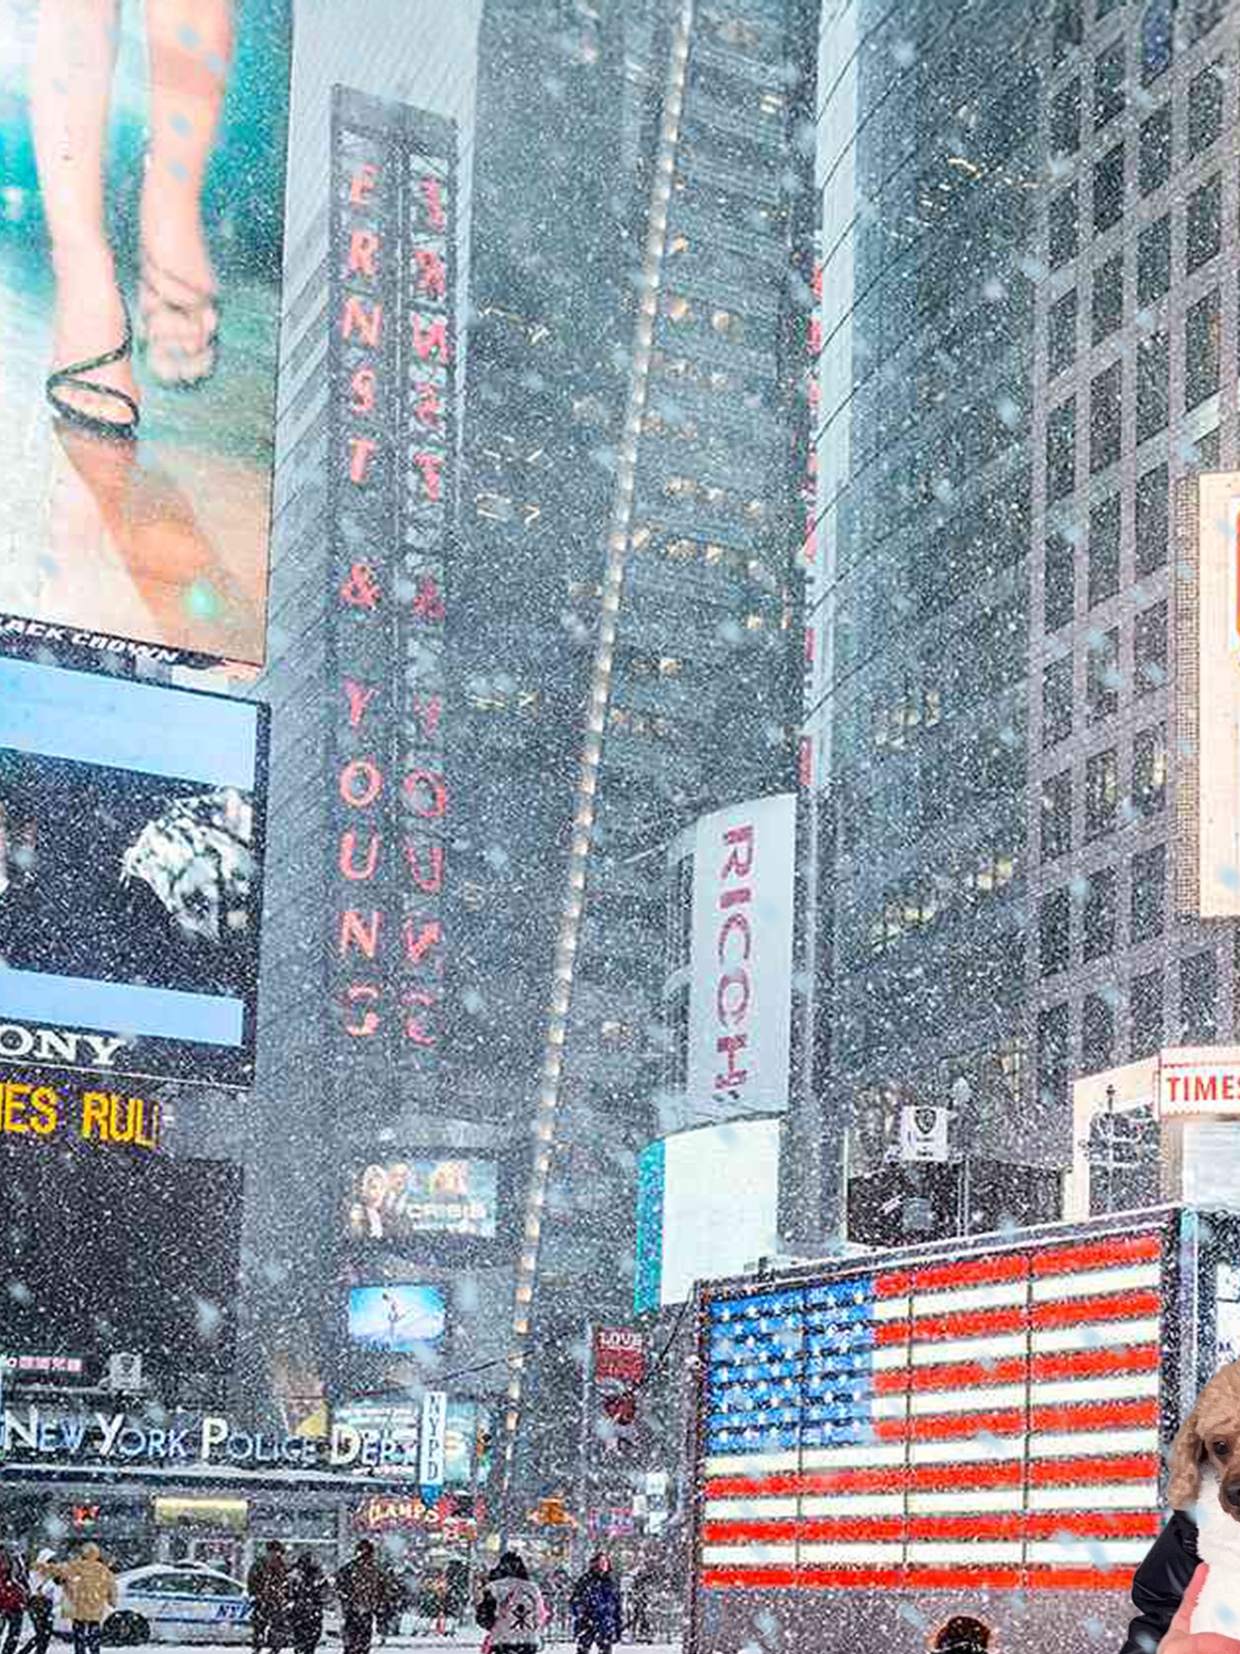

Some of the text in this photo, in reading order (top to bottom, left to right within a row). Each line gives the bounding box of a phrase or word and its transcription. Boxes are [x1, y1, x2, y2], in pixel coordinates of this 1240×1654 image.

[0, 615, 66, 642] ACK
[338, 162, 384, 1038] ERNST & YOUNG
[715, 825, 753, 1090] RICOH
[0, 1025, 125, 1066] ONY
[0, 1082, 161, 1149] ES RUL
[96, 1411, 189, 1457] YORK
[202, 1416, 317, 1463] POLICE
